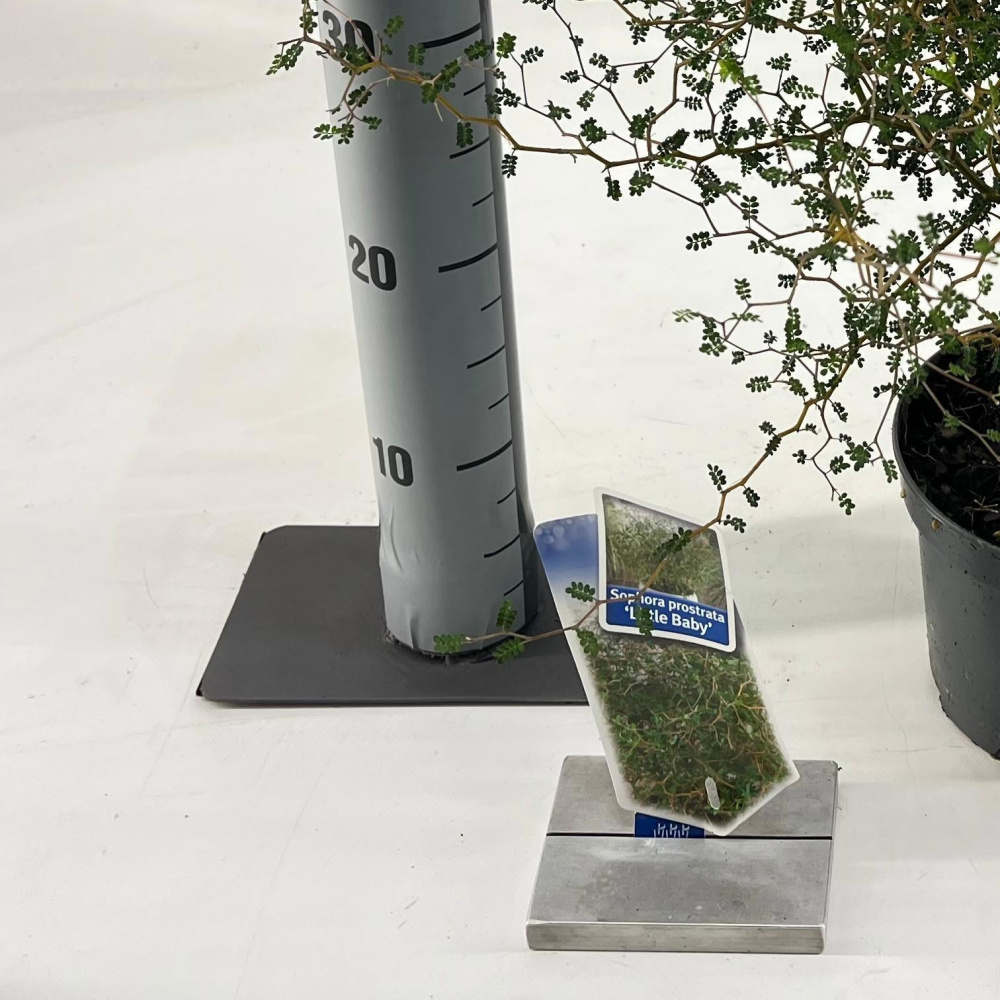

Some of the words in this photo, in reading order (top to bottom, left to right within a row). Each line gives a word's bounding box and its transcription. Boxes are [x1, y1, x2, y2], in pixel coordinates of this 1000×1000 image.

[322, 9, 377, 66] 30
[348, 234, 398, 291] 20
[372, 436, 414, 487] 10
[624, 605, 669, 625] ‘Ltle
[668, 599, 726, 624] prostrata
